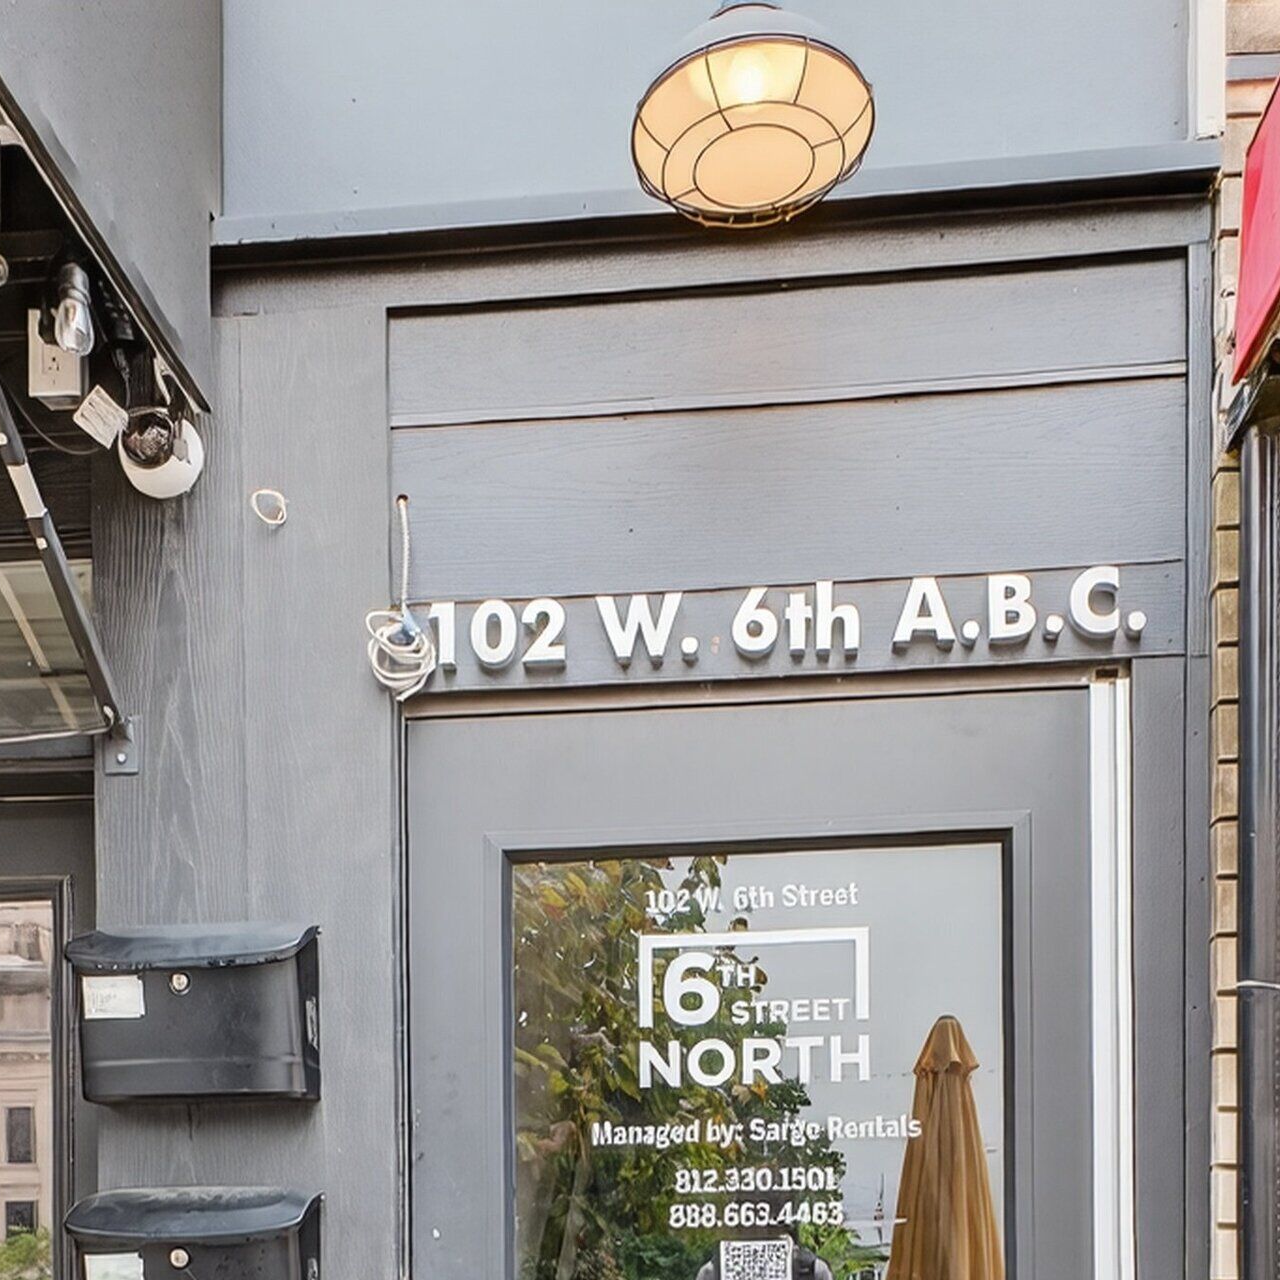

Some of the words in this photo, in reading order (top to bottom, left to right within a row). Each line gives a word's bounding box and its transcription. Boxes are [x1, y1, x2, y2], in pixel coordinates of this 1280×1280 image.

[427, 597, 568, 674] 102
[595, 591, 701, 668] W.
[730, 579, 863, 660] 6th
[890, 565, 1149, 652] A.B.C.
[644, 889, 691, 914] 102
[692, 884, 723, 914] W.
[733, 886, 774, 910] 6th
[781, 882, 859, 908] Street
[730, 997, 851, 1026] STREET
[638, 1033, 871, 1090] NORTH
[591, 1119, 699, 1149] Managed
[706, 1119, 744, 1148] by:
[827, 1114, 922, 1141] Rentals
